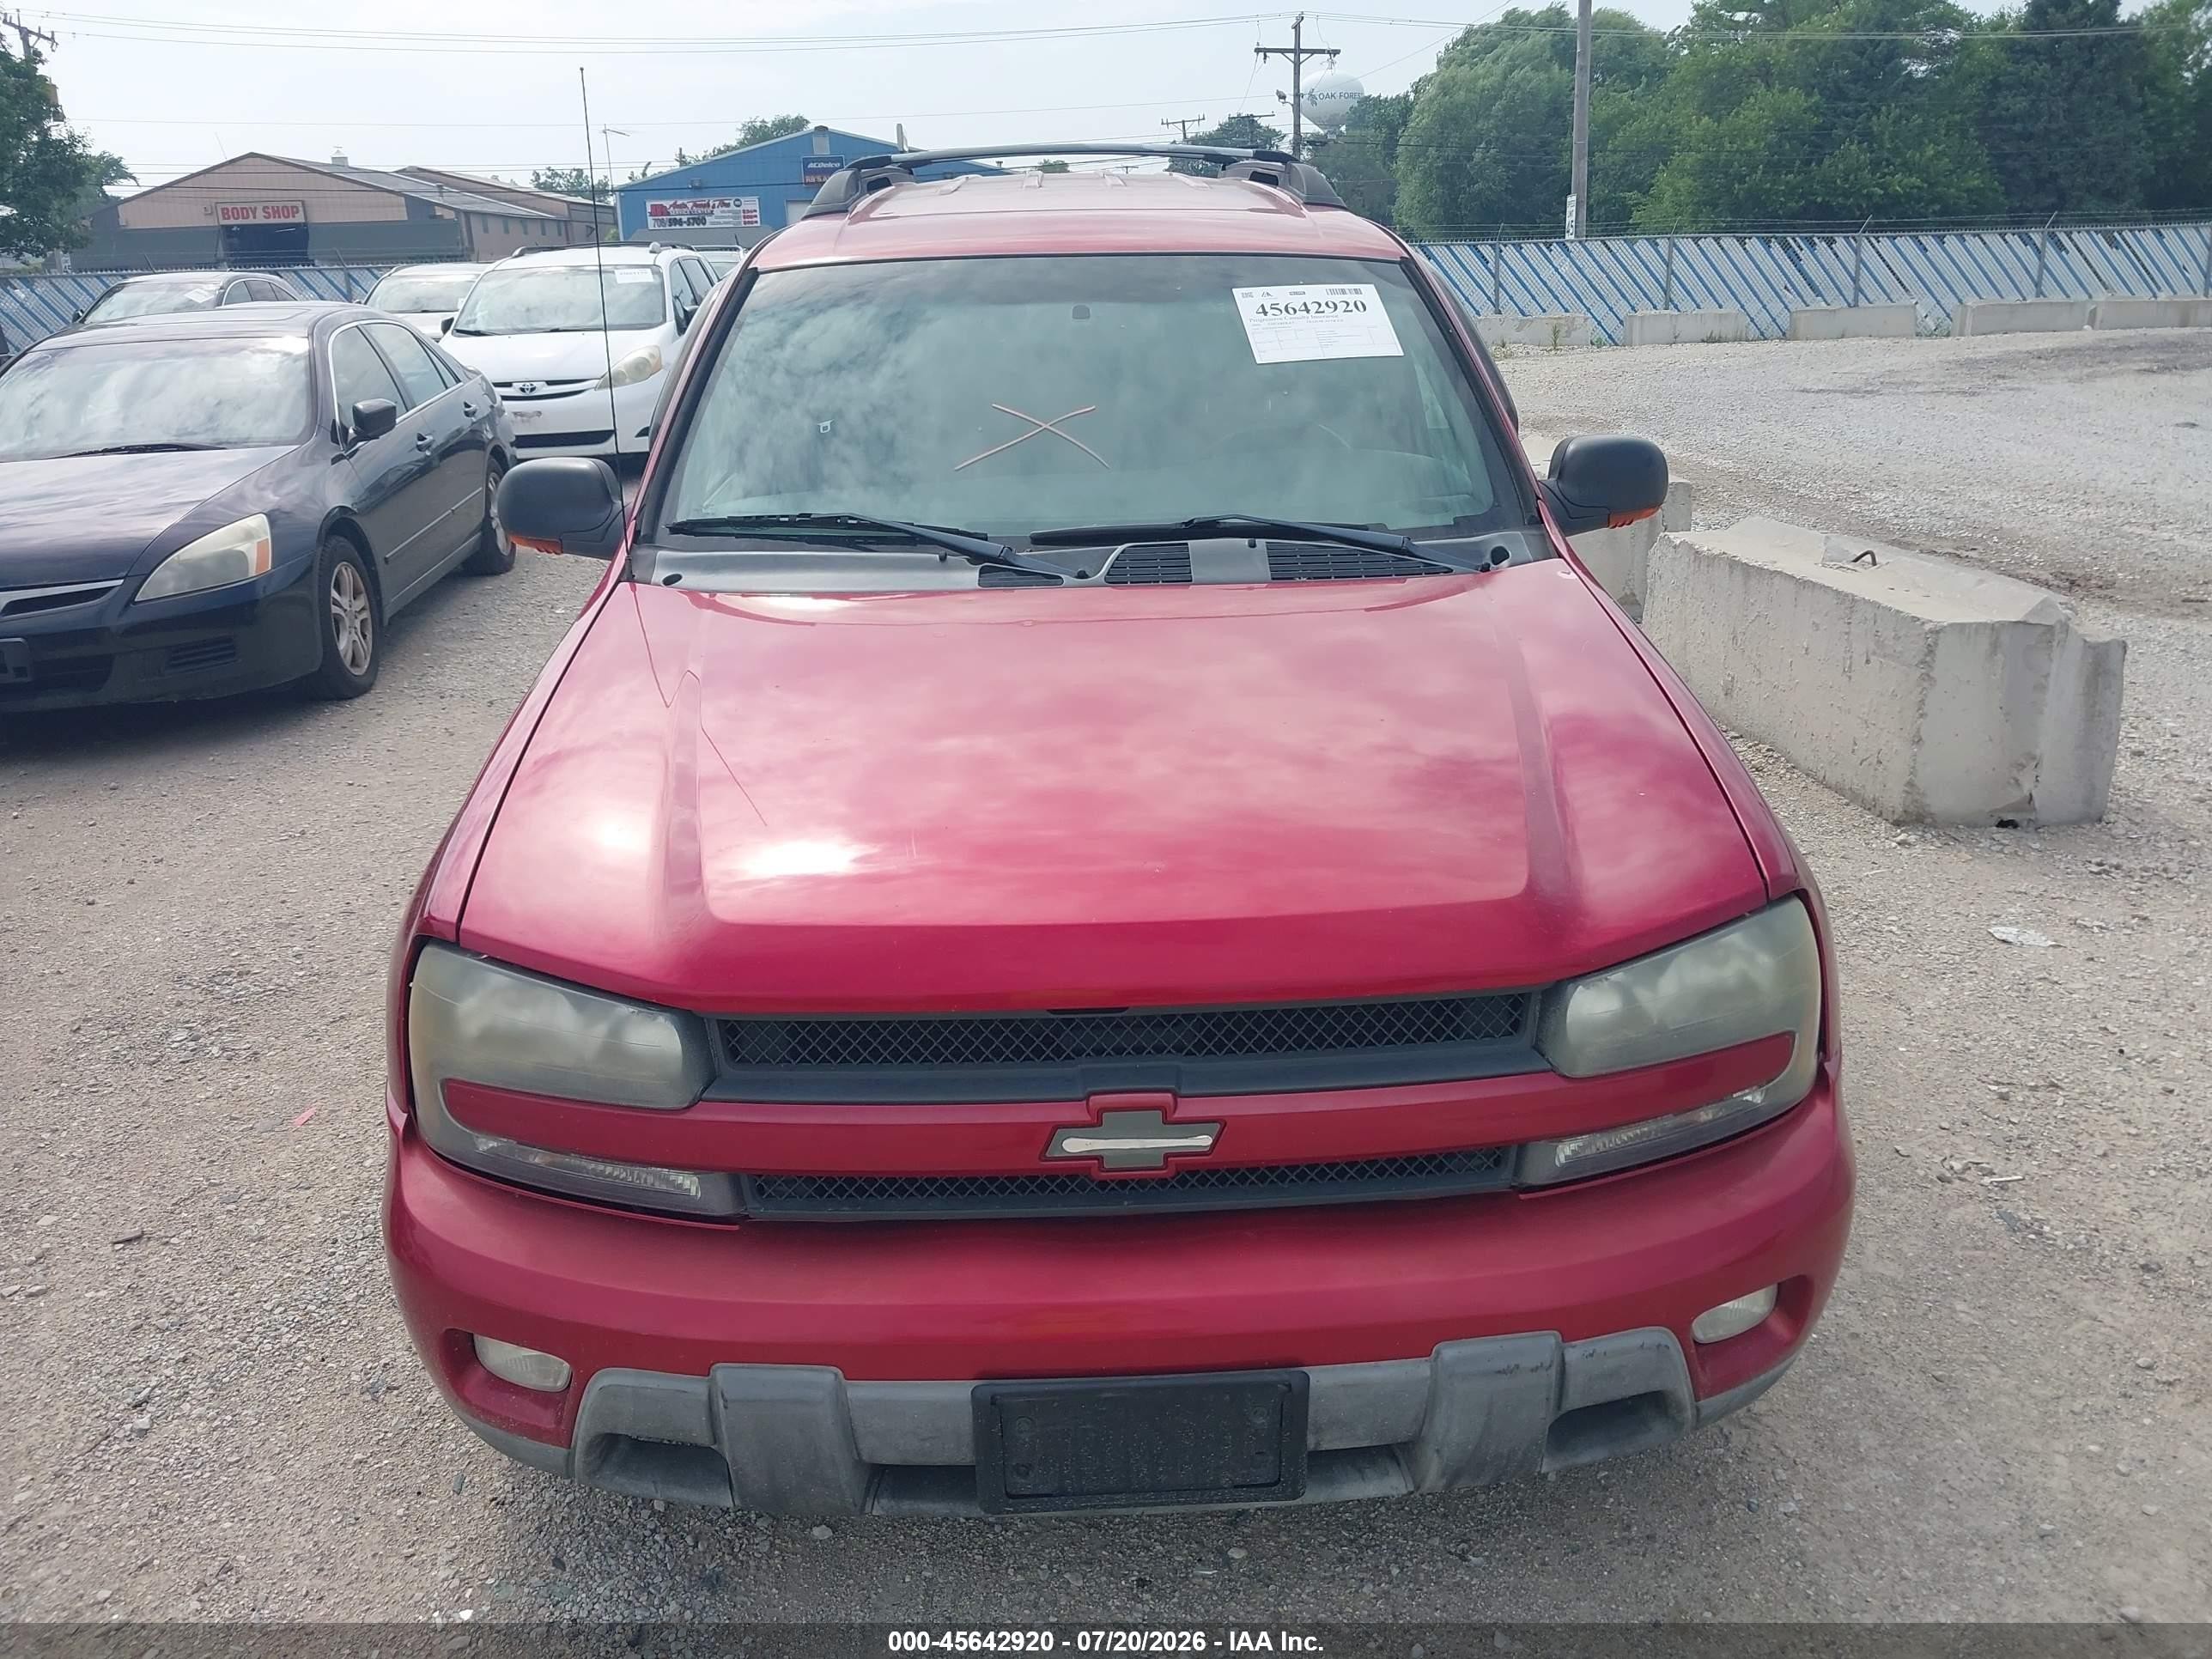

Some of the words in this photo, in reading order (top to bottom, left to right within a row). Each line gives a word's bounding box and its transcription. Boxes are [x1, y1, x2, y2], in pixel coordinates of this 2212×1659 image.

[1318, 92, 1336, 100] OAK
[221, 206, 258, 221] BODY
[261, 205, 300, 220] SHOP
[1255, 300, 1367, 317] 45642920
